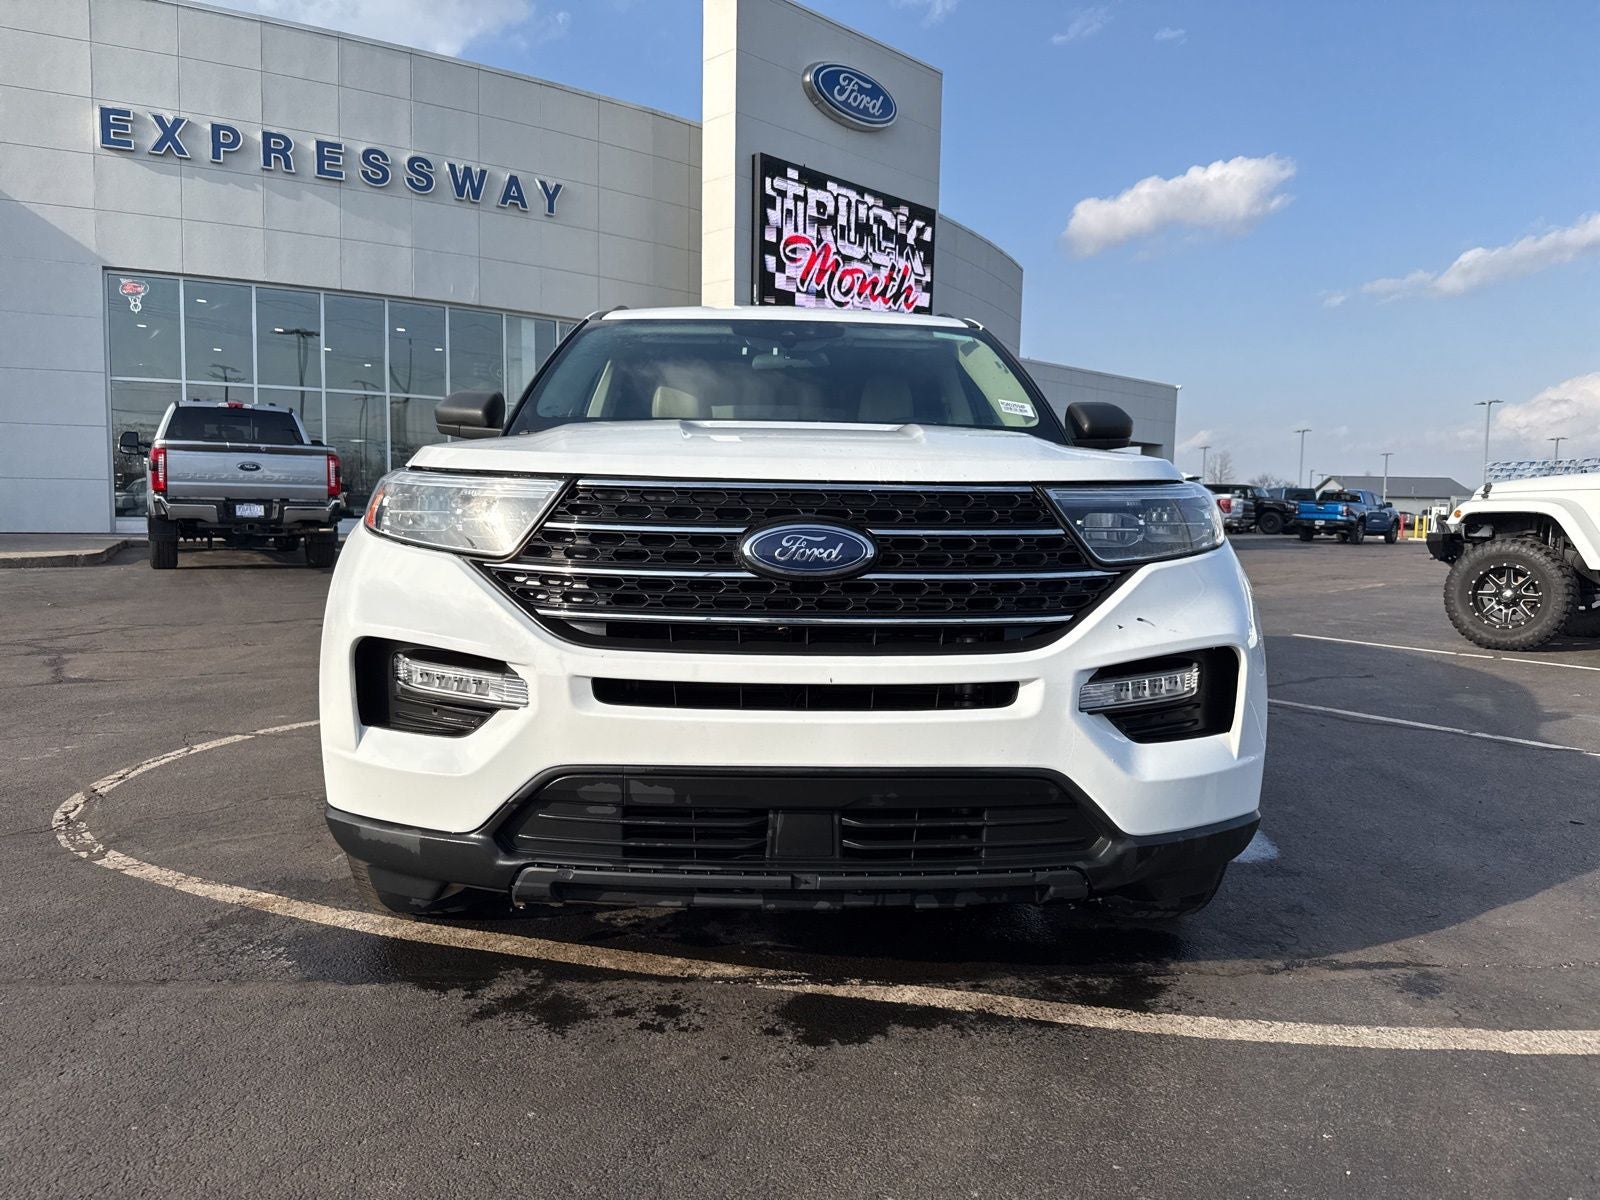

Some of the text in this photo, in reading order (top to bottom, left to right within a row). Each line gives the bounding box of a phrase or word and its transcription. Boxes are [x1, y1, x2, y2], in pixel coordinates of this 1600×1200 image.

[833, 72, 883, 117] Ford
[98, 105, 564, 217] EXPRESSWAY
[772, 176, 926, 278] TRUCK
[780, 233, 919, 312] Month
[774, 534, 845, 563] Ford
